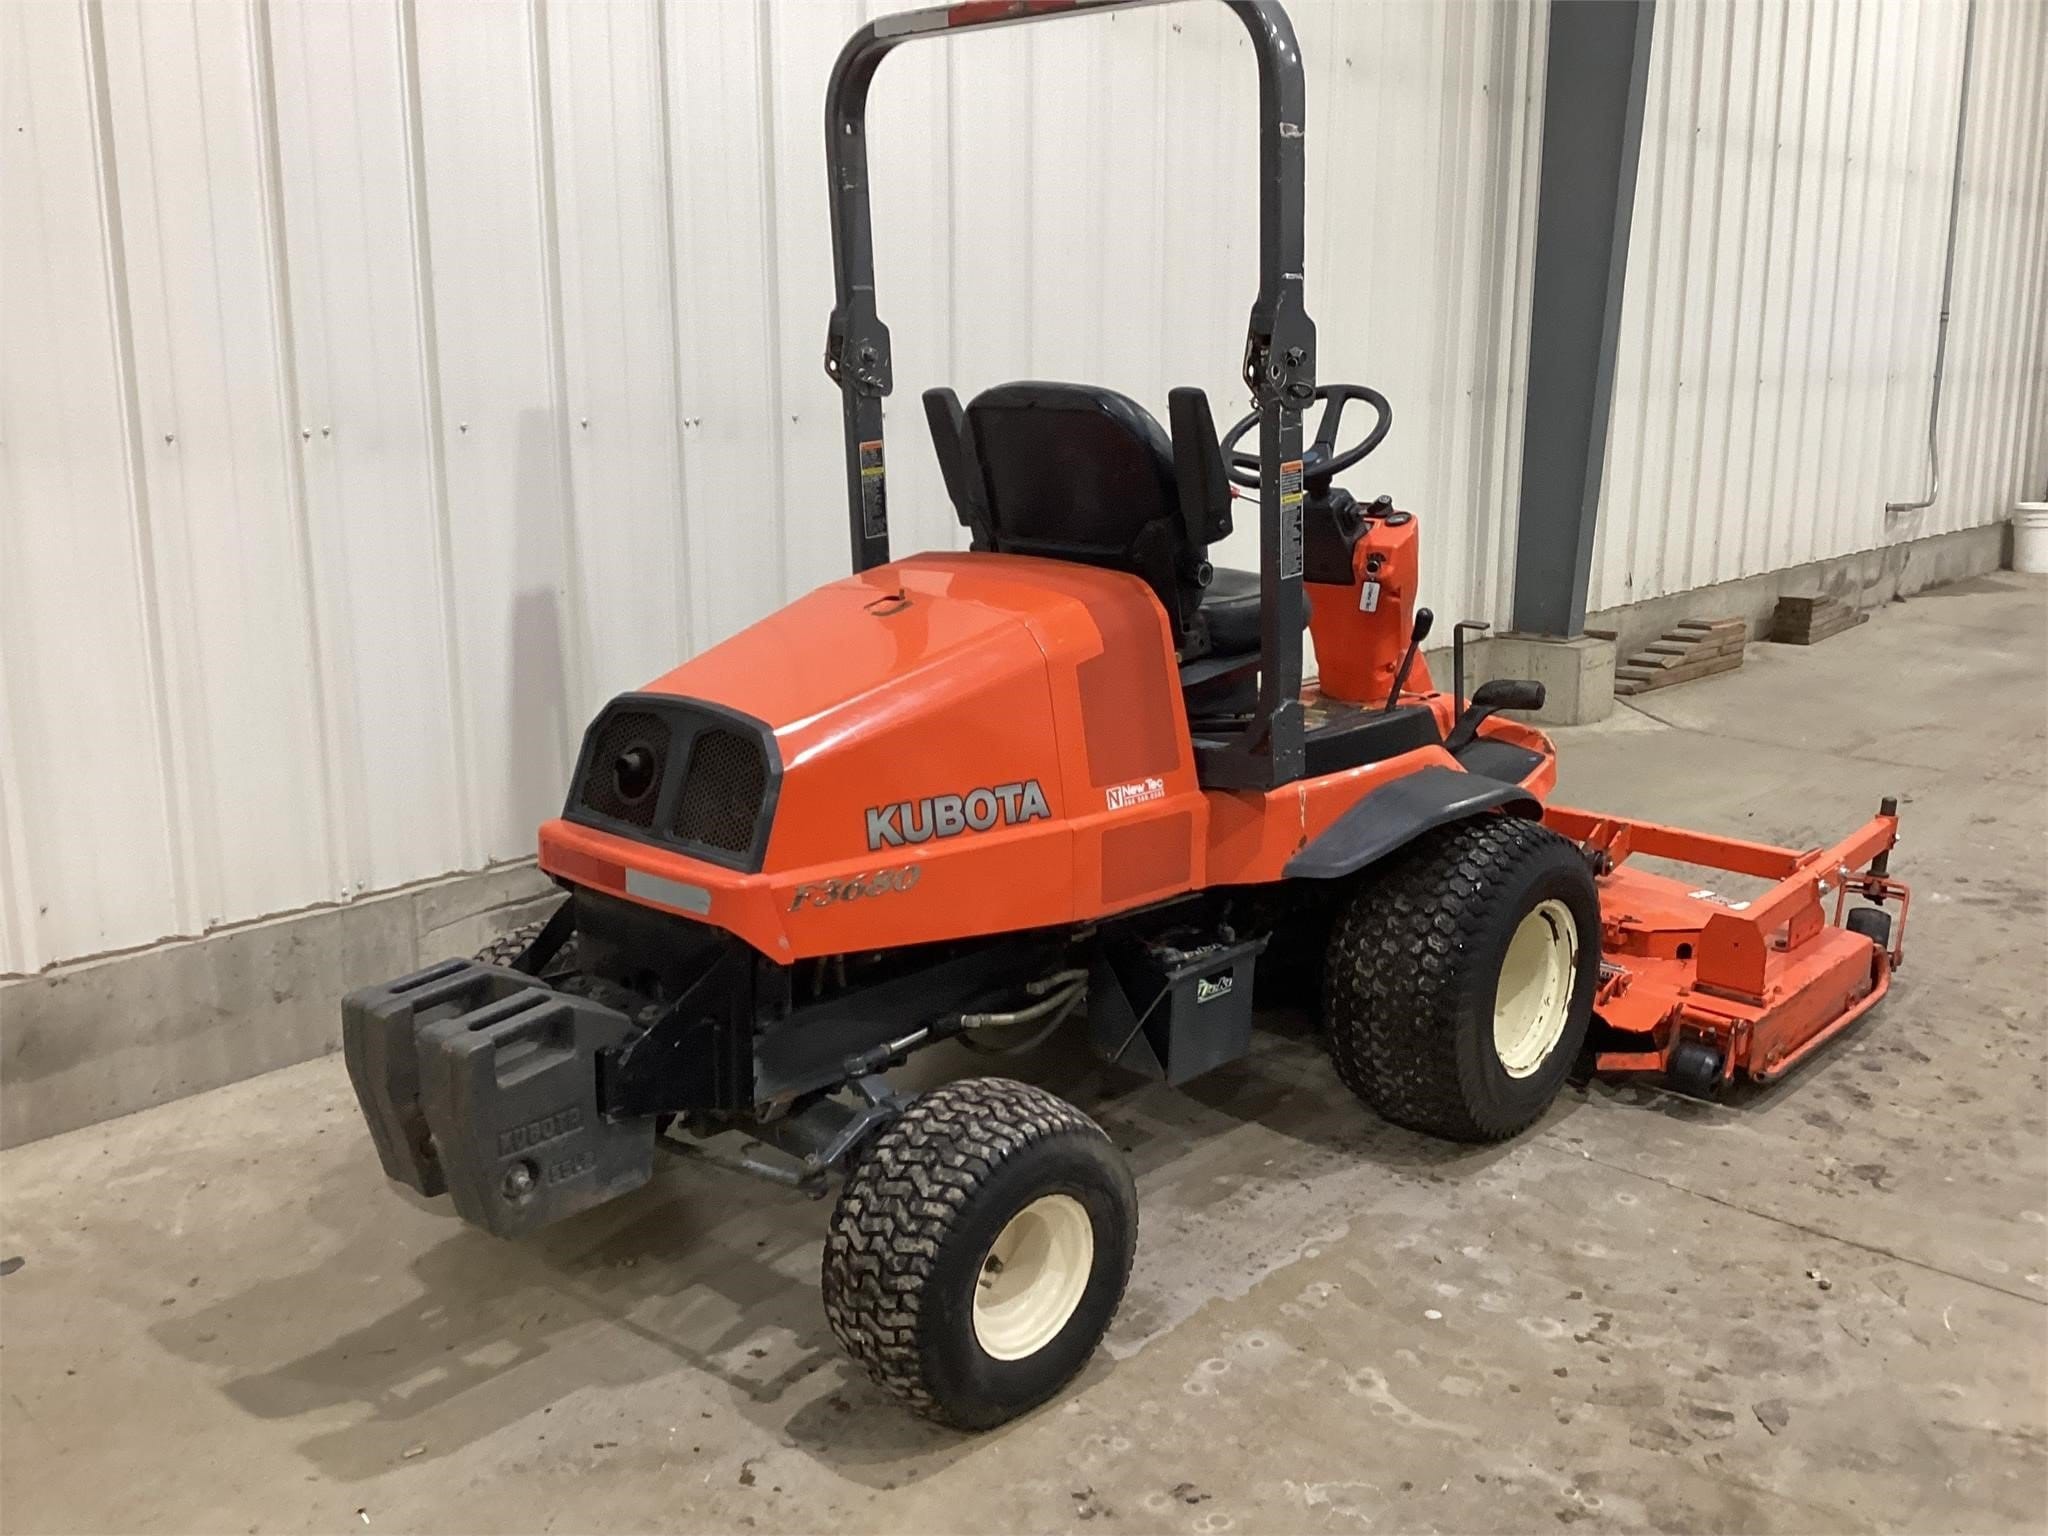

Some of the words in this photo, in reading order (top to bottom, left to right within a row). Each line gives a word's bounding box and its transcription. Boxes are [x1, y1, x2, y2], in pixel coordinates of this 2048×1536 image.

[1122, 783, 1145, 797] New
[865, 780, 1051, 851] KUBOTA
[786, 864, 922, 912] F3680
